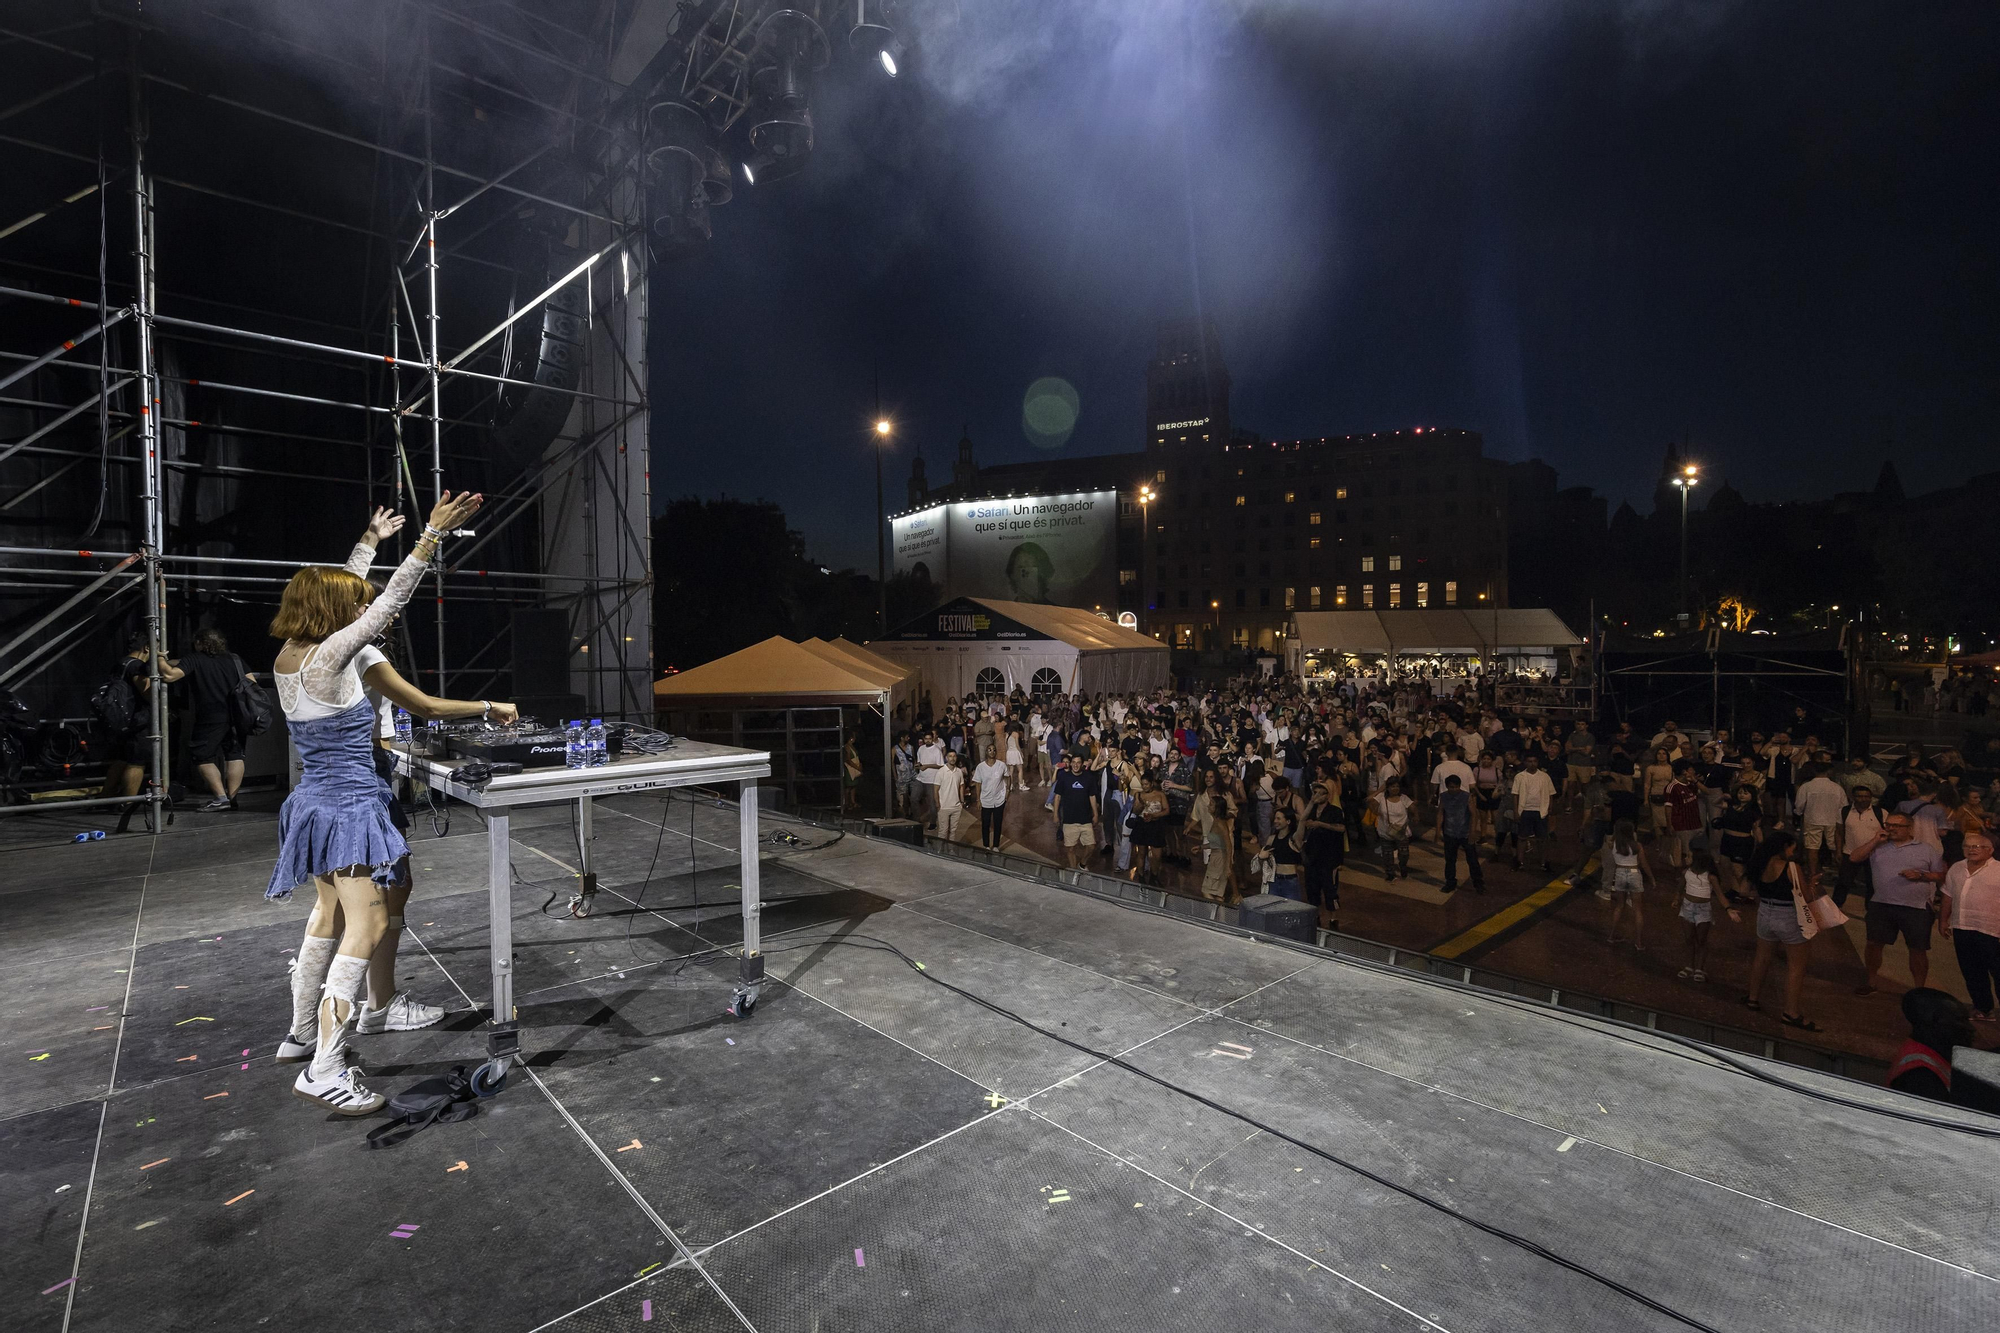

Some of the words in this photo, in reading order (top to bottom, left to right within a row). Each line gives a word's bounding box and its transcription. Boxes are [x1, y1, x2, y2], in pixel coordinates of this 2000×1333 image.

[1157, 420, 1204, 430] IBEROSTAR
[977, 506, 1011, 518] Safari.
[1013, 504, 1029, 515] Un
[1032, 500, 1094, 514] navegador
[975, 522, 995, 533] que
[998, 519, 1007, 530] sí
[1009, 520, 1031, 531] que
[1033, 517, 1047, 527] és
[1049, 515, 1085, 529] privat.
[911, 527, 934, 539] navegador
[938, 615, 976, 631] FESTIVAL
